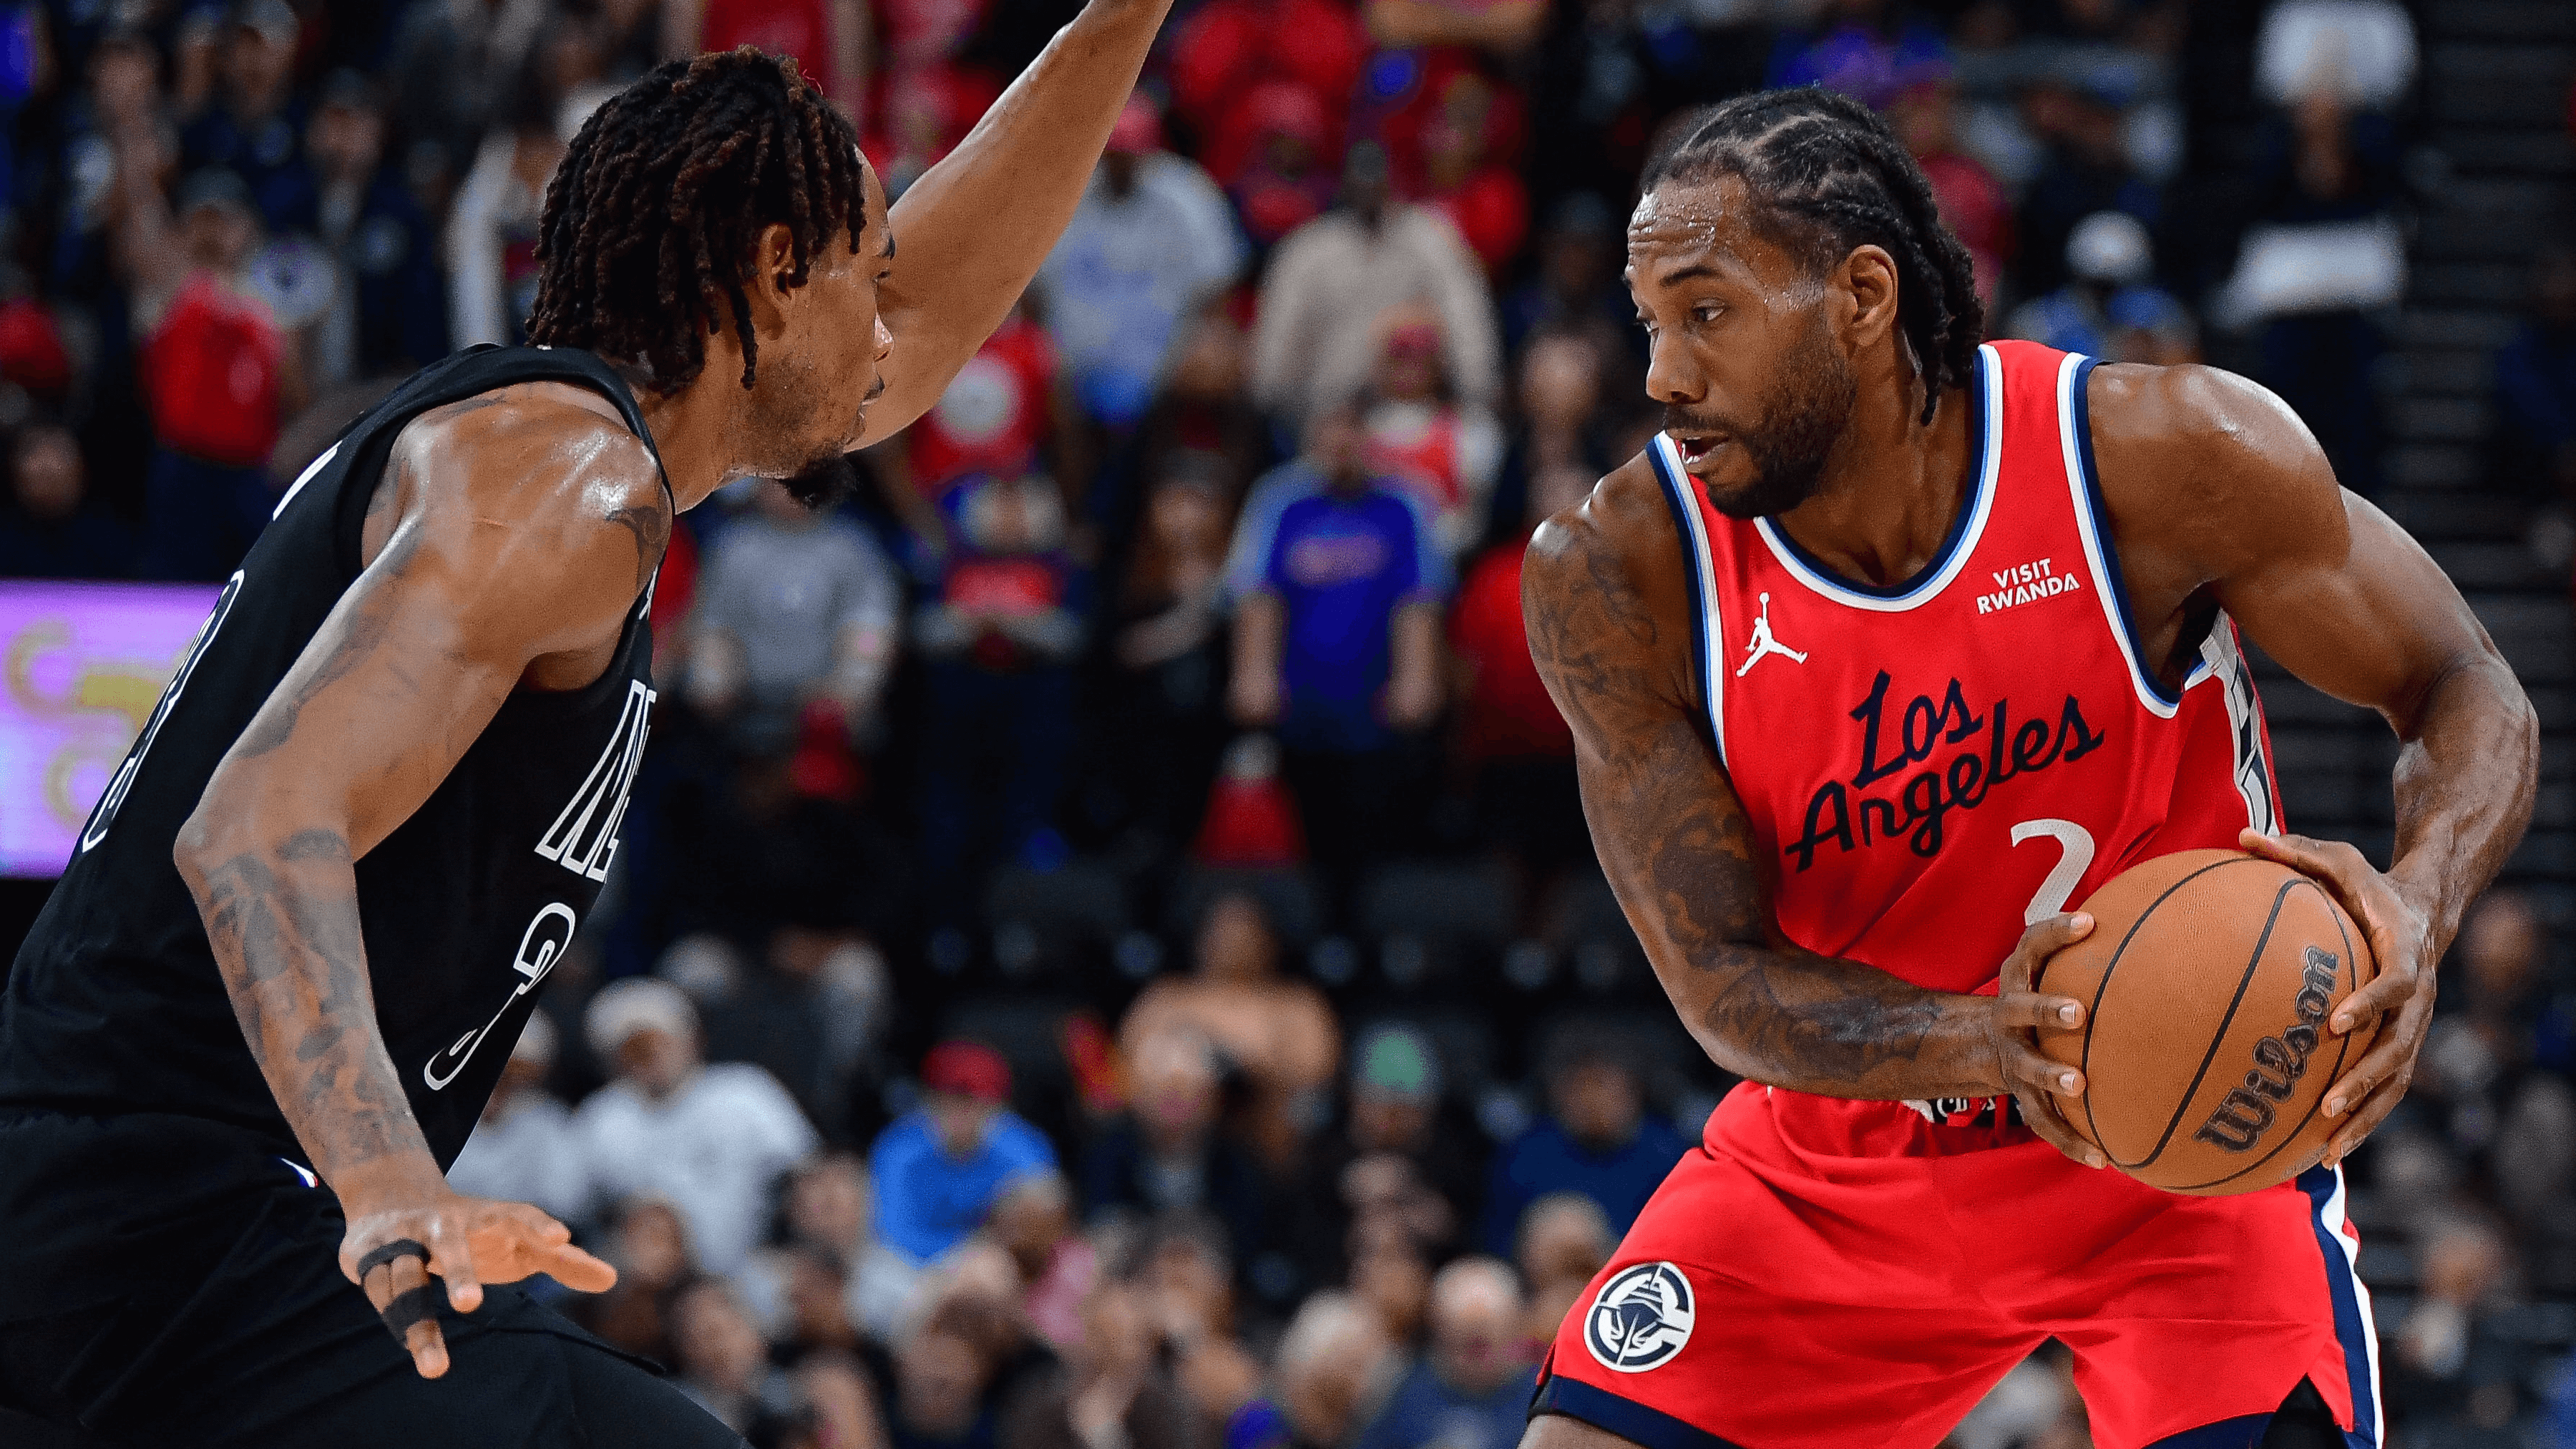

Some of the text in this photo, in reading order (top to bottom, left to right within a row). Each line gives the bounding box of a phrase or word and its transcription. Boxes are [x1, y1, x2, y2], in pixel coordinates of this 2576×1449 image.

[1976, 572, 2081, 615] RWANDA
[1993, 557, 2051, 589] VISIT
[1785, 696, 2104, 873] Angeles
[1850, 670, 1984, 789] Los
[2010, 818, 2095, 927] 2
[2192, 945, 2338, 1154] Wilson
